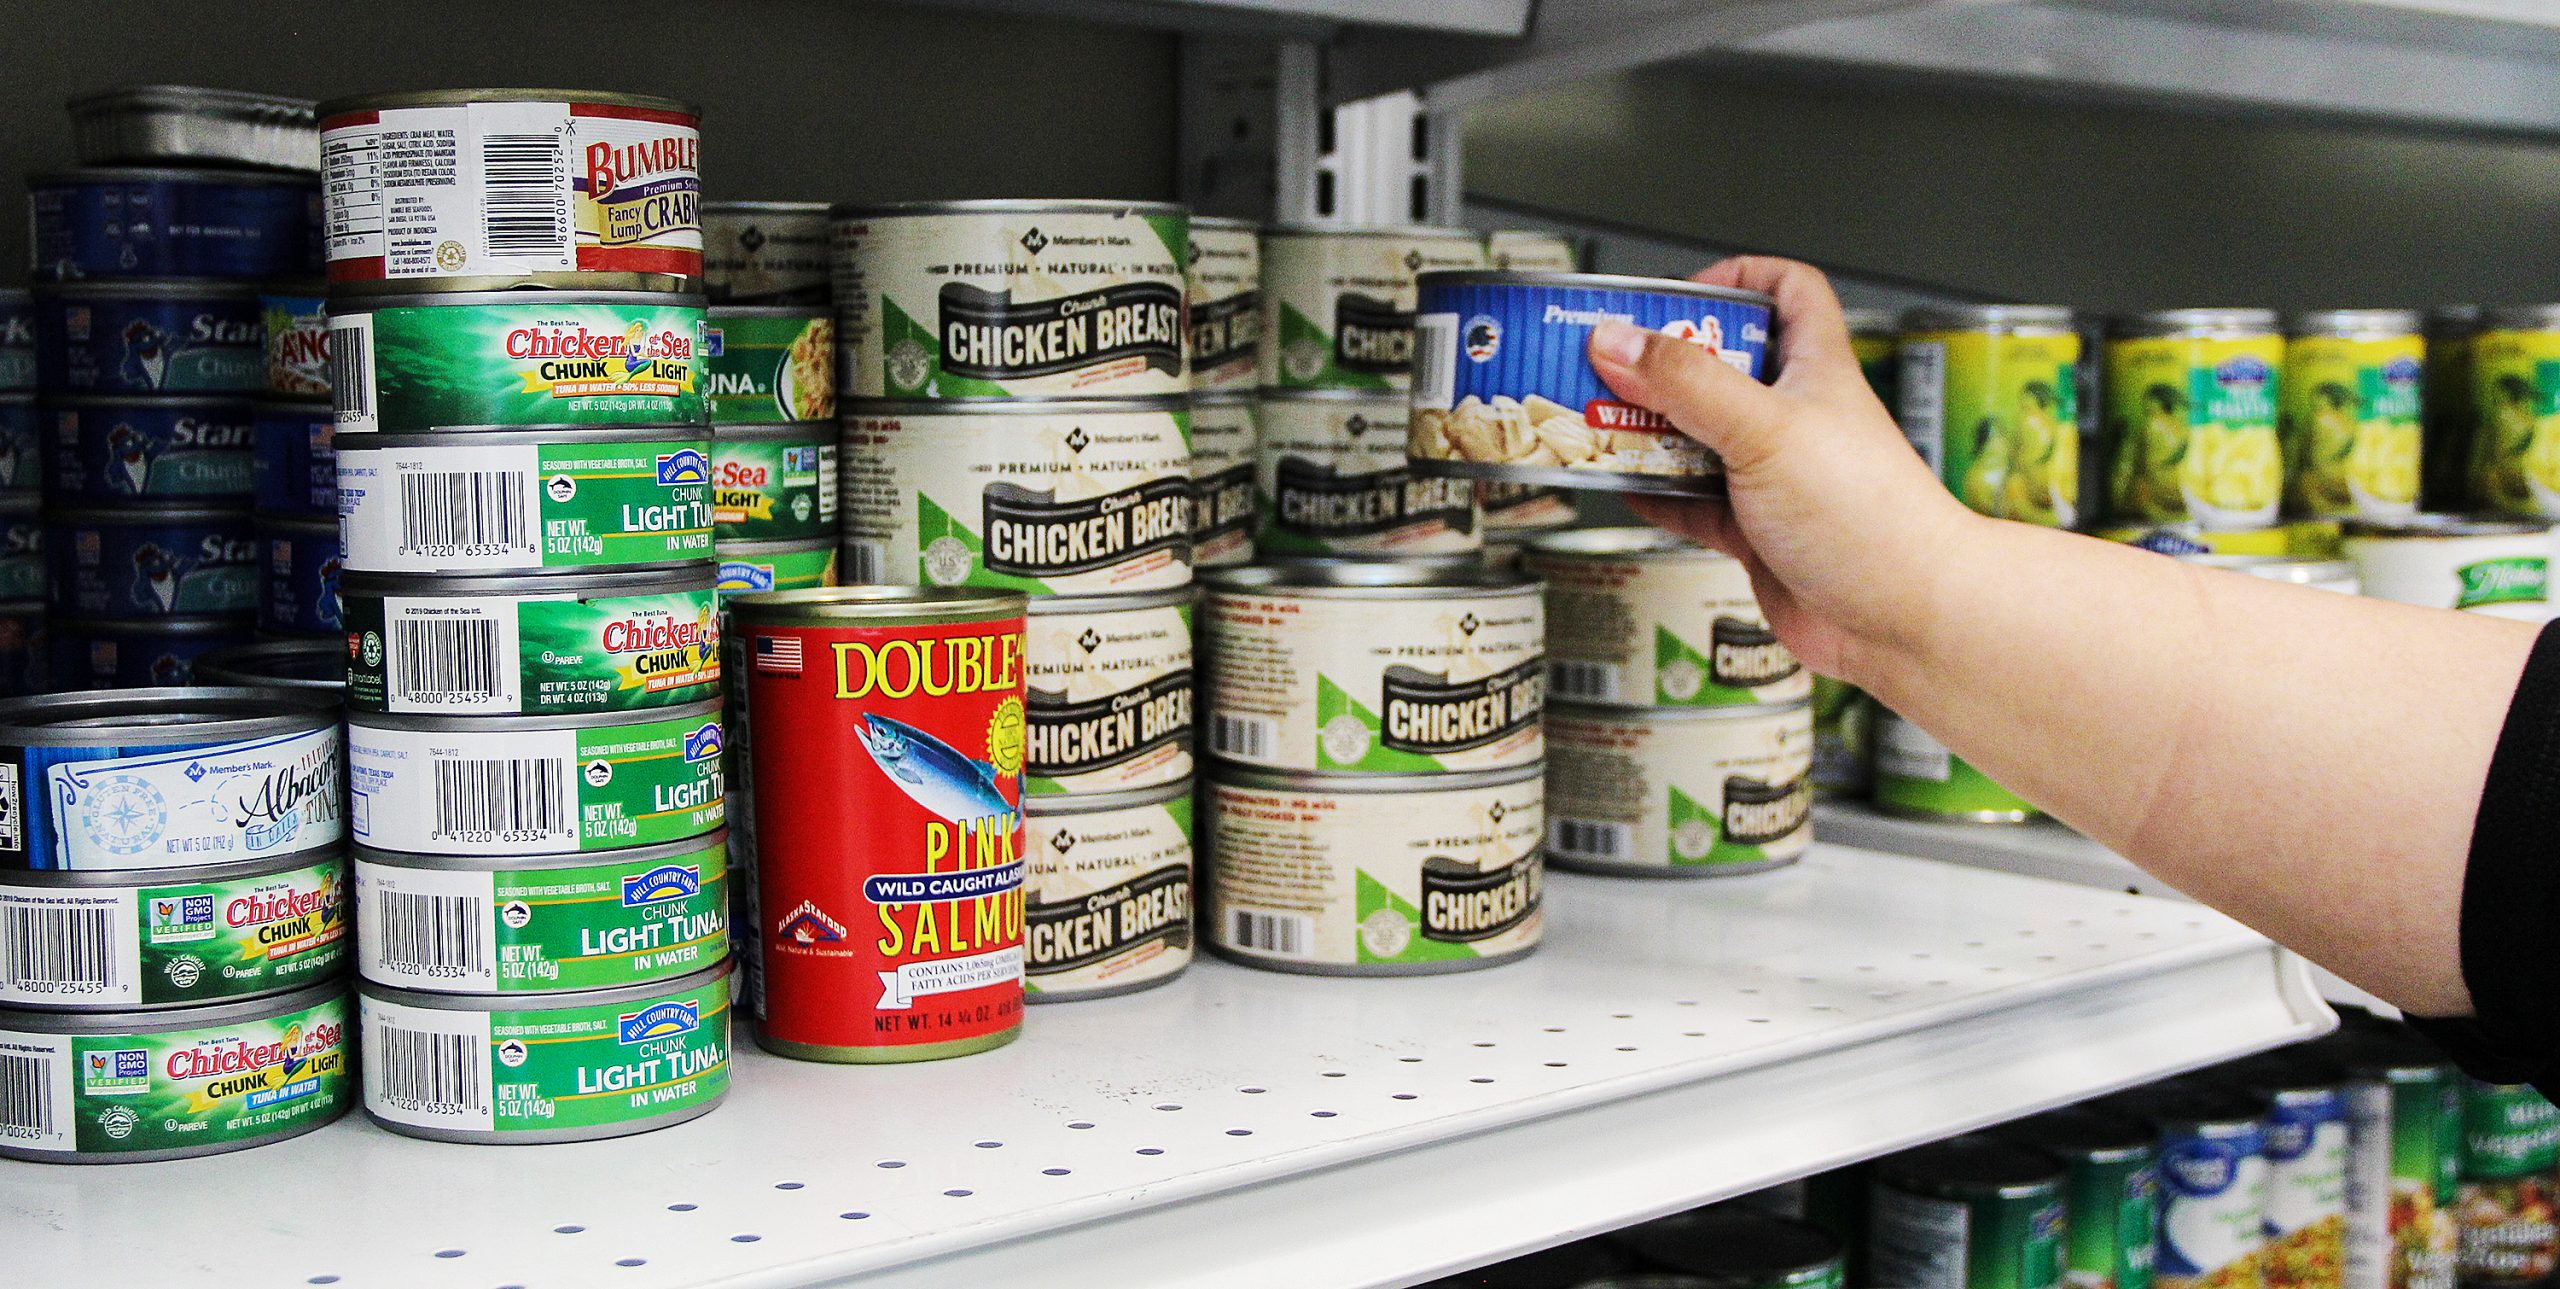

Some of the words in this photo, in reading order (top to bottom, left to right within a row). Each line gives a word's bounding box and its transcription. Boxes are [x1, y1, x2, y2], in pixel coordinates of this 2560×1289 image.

[438, 130, 454, 138] WATER,
[586, 137, 697, 201] BUMBLE
[643, 181, 683, 197] Premium
[608, 206, 641, 223] Fancy
[611, 222, 642, 240] Lump
[954, 263, 1028, 276] PREMIUM
[1048, 263, 1114, 275] NATURAL
[948, 318, 1087, 367] CHICKEN
[1097, 298, 1179, 350] BREAST
[507, 328, 626, 360] Chicken
[661, 331, 691, 359] Sea
[541, 362, 608, 380] CHUNK
[653, 360, 687, 381] LIGHT
[555, 385, 577, 393] TUNA
[590, 384, 617, 392] WATER
[542, 460, 572, 470] SEASONED
[587, 459, 616, 469] VEGETABLE
[999, 462, 1073, 474] PREMIUM
[1089, 460, 1148, 473] NATURAL
[721, 461, 767, 488] Sea
[672, 487, 703, 501] CHUNK
[1281, 488, 1398, 525] CHICKEN
[547, 520, 566, 536] NET
[568, 519, 589, 536] WT.
[623, 505, 687, 532] LIGHT
[557, 537, 571, 553] OZ
[573, 535, 603, 555] (142g)
[667, 537, 680, 550] IN
[683, 534, 708, 549] WATER
[990, 513, 1125, 565] CHICKEN
[415, 544, 455, 557] 41220
[466, 544, 509, 556] 65334
[603, 617, 700, 654] Chicken
[555, 656, 583, 664] PAREVE
[636, 650, 689, 674] CHUNK
[831, 634, 1019, 700] DOUBLE
[540, 682, 555, 691] NET
[408, 693, 442, 703] 48000
[449, 693, 488, 703] 25455
[1388, 696, 1506, 741] CHICKEN
[209, 763, 251, 774] Member's
[655, 780, 709, 812] LIGHT
[11, 781, 19, 849] how2recycle.info
[584, 806, 603, 820] NET
[605, 803, 624, 818] WT.
[450, 832, 492, 842] 41220
[503, 831, 547, 842] 65334
[594, 821, 607, 836] OZ
[609, 818, 637, 838] (142g)
[167, 839, 180, 852] NET
[182, 838, 192, 851] WT
[926, 811, 1016, 873] PINK
[1076, 857, 1136, 871] NATURAL
[543, 885, 575, 895] VEGETABLE
[631, 883, 649, 901] HILL
[649, 871, 681, 888] COUNTRY
[876, 882, 925, 896] WILD
[929, 876, 995, 894] CAUGHT
[185, 898, 211, 907] NON
[185, 907, 211, 916] GMO
[227, 888, 322, 928] Chicken
[642, 900, 688, 920] CHUNK
[1426, 876, 1528, 931] CHICKEN
[186, 914, 211, 923] Project
[778, 904, 804, 933] ALASKA
[804, 899, 847, 938] SEAFOOD
[156, 924, 212, 934] VERIFIED
[258, 917, 311, 943] CHUNK
[582, 924, 663, 955] LIGHT
[502, 947, 521, 962] NET
[523, 945, 544, 961] WT.
[634, 957, 651, 970] IN
[656, 946, 698, 967] WATER
[788, 946, 807, 955] Natural
[816, 948, 853, 957] Sustainable
[180, 954, 206, 971] CAUGHT
[391, 961, 421, 977] 41220
[428, 964, 466, 978] 65334
[511, 963, 525, 978] OZ
[528, 961, 559, 980] (142g)
[909, 962, 964, 978] CONTAINS
[235, 967, 261, 978] PAREVE
[17, 982, 54, 993] 48000
[61, 983, 102, 993] 25455
[911, 978, 944, 991] FATTY
[946, 973, 975, 986] ACIDS
[627, 1021, 647, 1039] HILL
[646, 1008, 679, 1026] COUNTRY
[875, 1017, 900, 1032] NET
[908, 1014, 931, 1030] WT.
[316, 1023, 341, 1050] Sea
[639, 1036, 687, 1057] CHUNK
[119, 1052, 144, 1060] NON
[119, 1060, 145, 1069] GMO
[167, 1041, 287, 1080] Chicken
[311, 1053, 339, 1074] LIGHT
[90, 1078, 145, 1086] VERIFIED
[207, 1073, 268, 1098] CHUNK
[578, 1059, 660, 1094] LIGHT
[252, 1092, 277, 1105] TUNA
[290, 1080, 318, 1095] WATER
[499, 1085, 517, 1100] NET
[519, 1083, 540, 1099] WT.
[631, 1094, 648, 1107] IN
[653, 1081, 696, 1103] WATER
[114, 1105, 140, 1122] CAUGHT
[391, 1096, 419, 1112] 41220
[427, 1102, 464, 1116] 65334
[507, 1101, 522, 1116] OZ
[524, 1099, 555, 1118] (142g)
[8, 1126, 40, 1140] 00245
[178, 1121, 208, 1132] PAREVE
